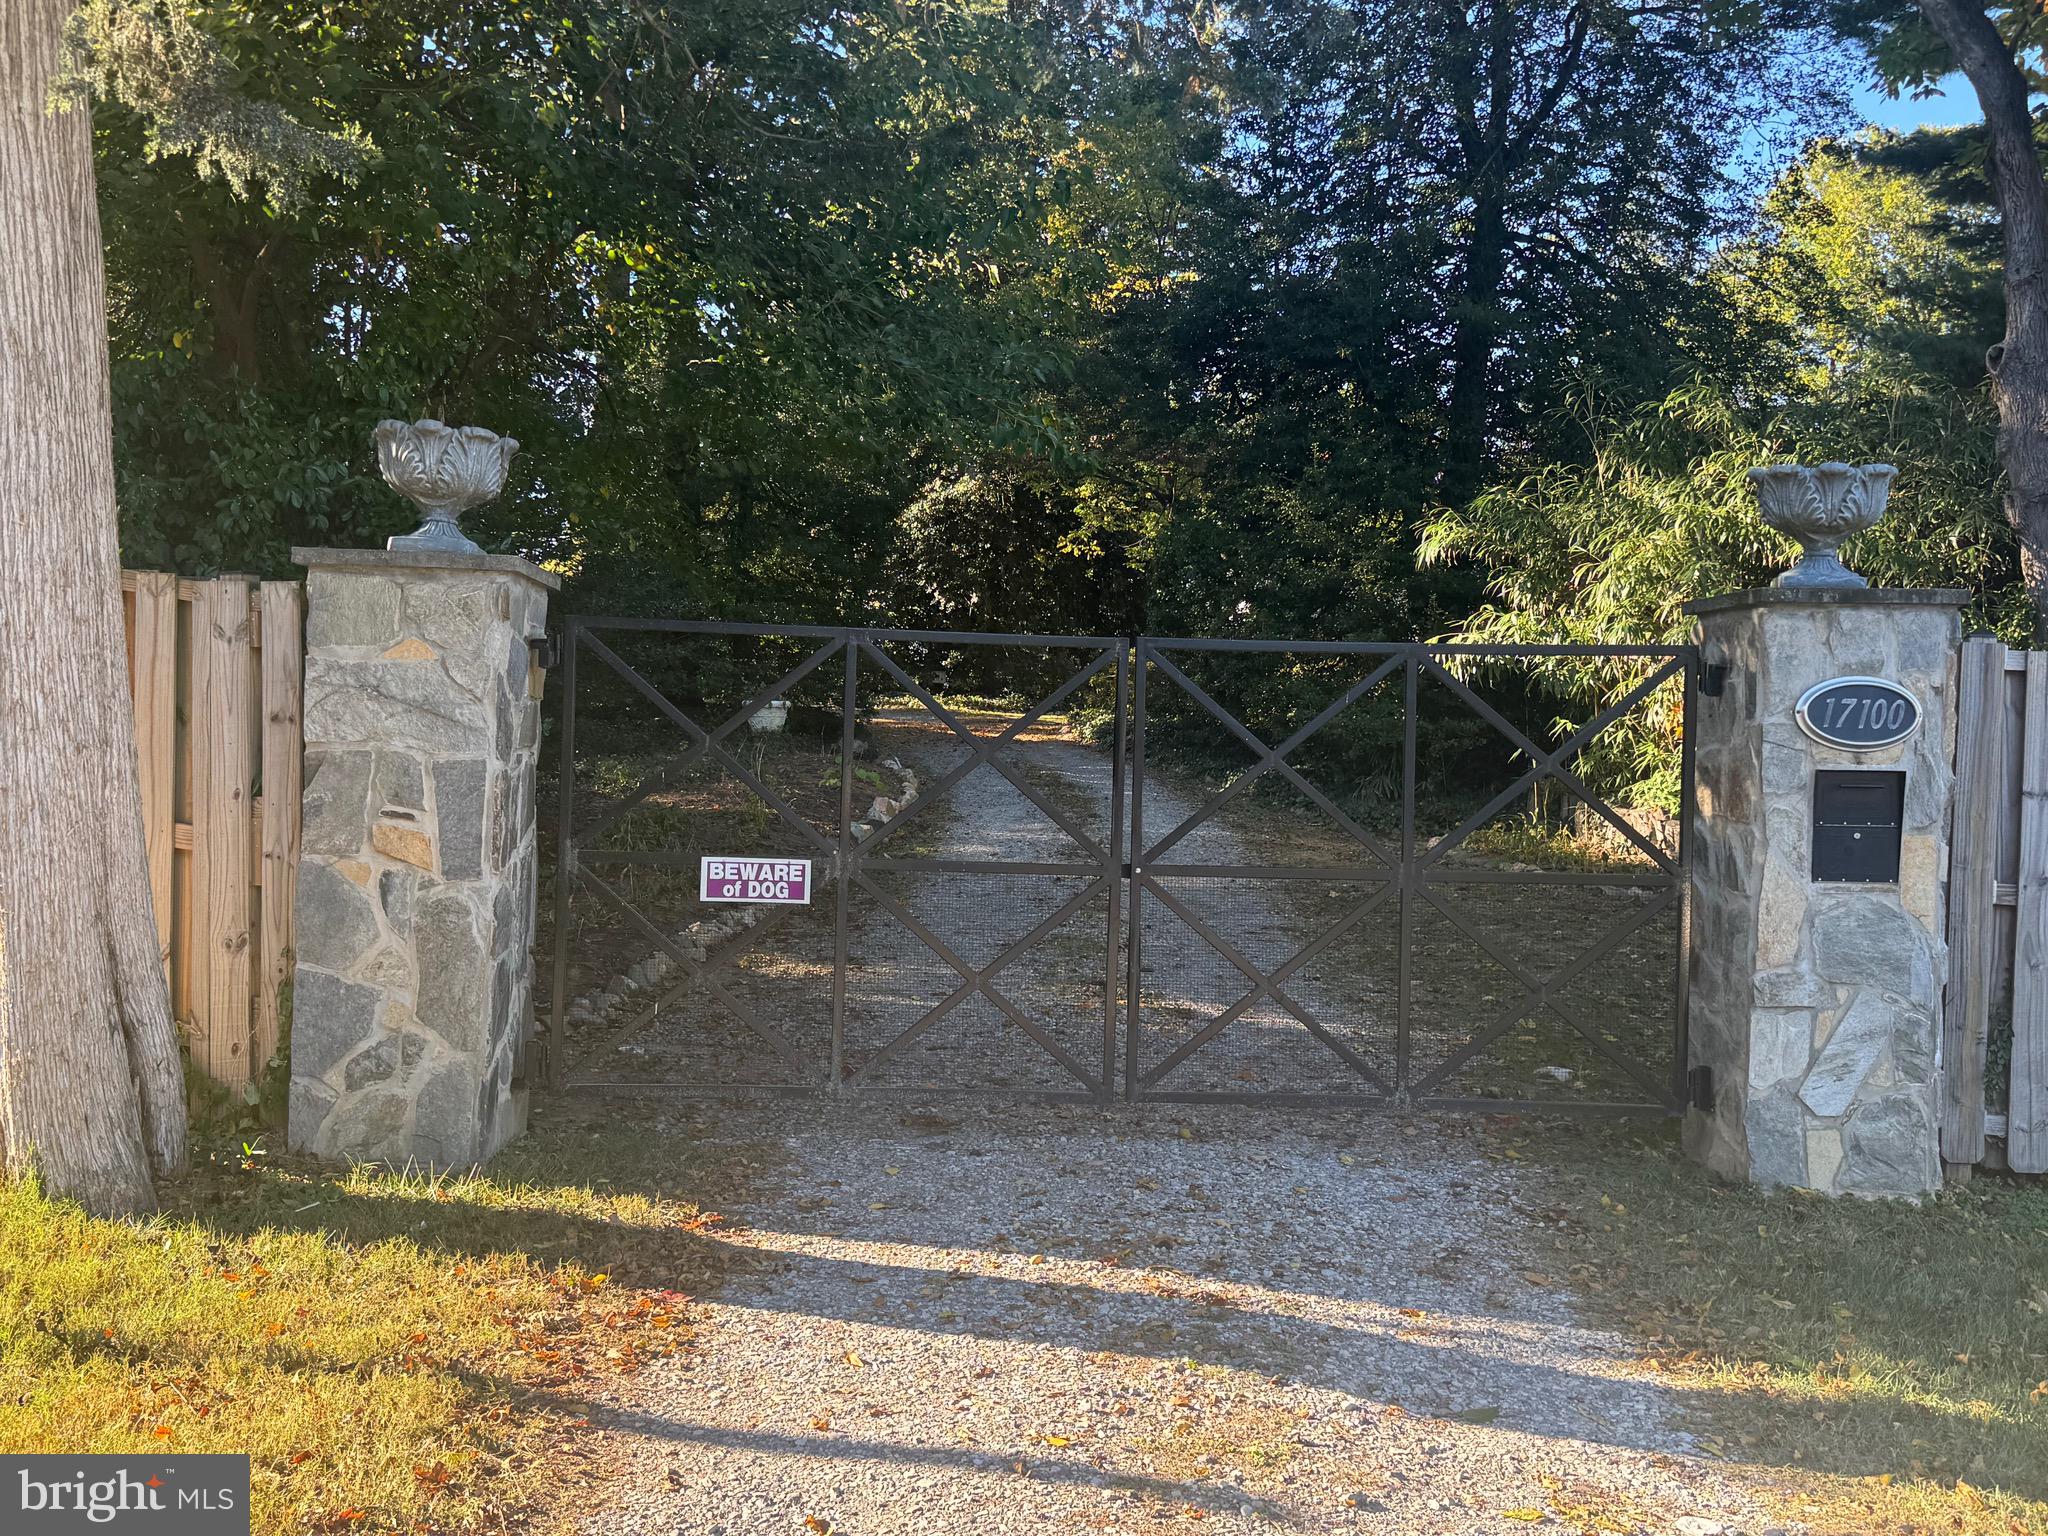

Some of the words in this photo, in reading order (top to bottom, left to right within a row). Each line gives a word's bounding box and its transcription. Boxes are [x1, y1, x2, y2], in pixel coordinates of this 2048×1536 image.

[1823, 698, 1906, 730] 17100
[709, 862, 803, 882] BEWARE
[722, 881, 742, 897] of
[748, 881, 789, 898] DOG
